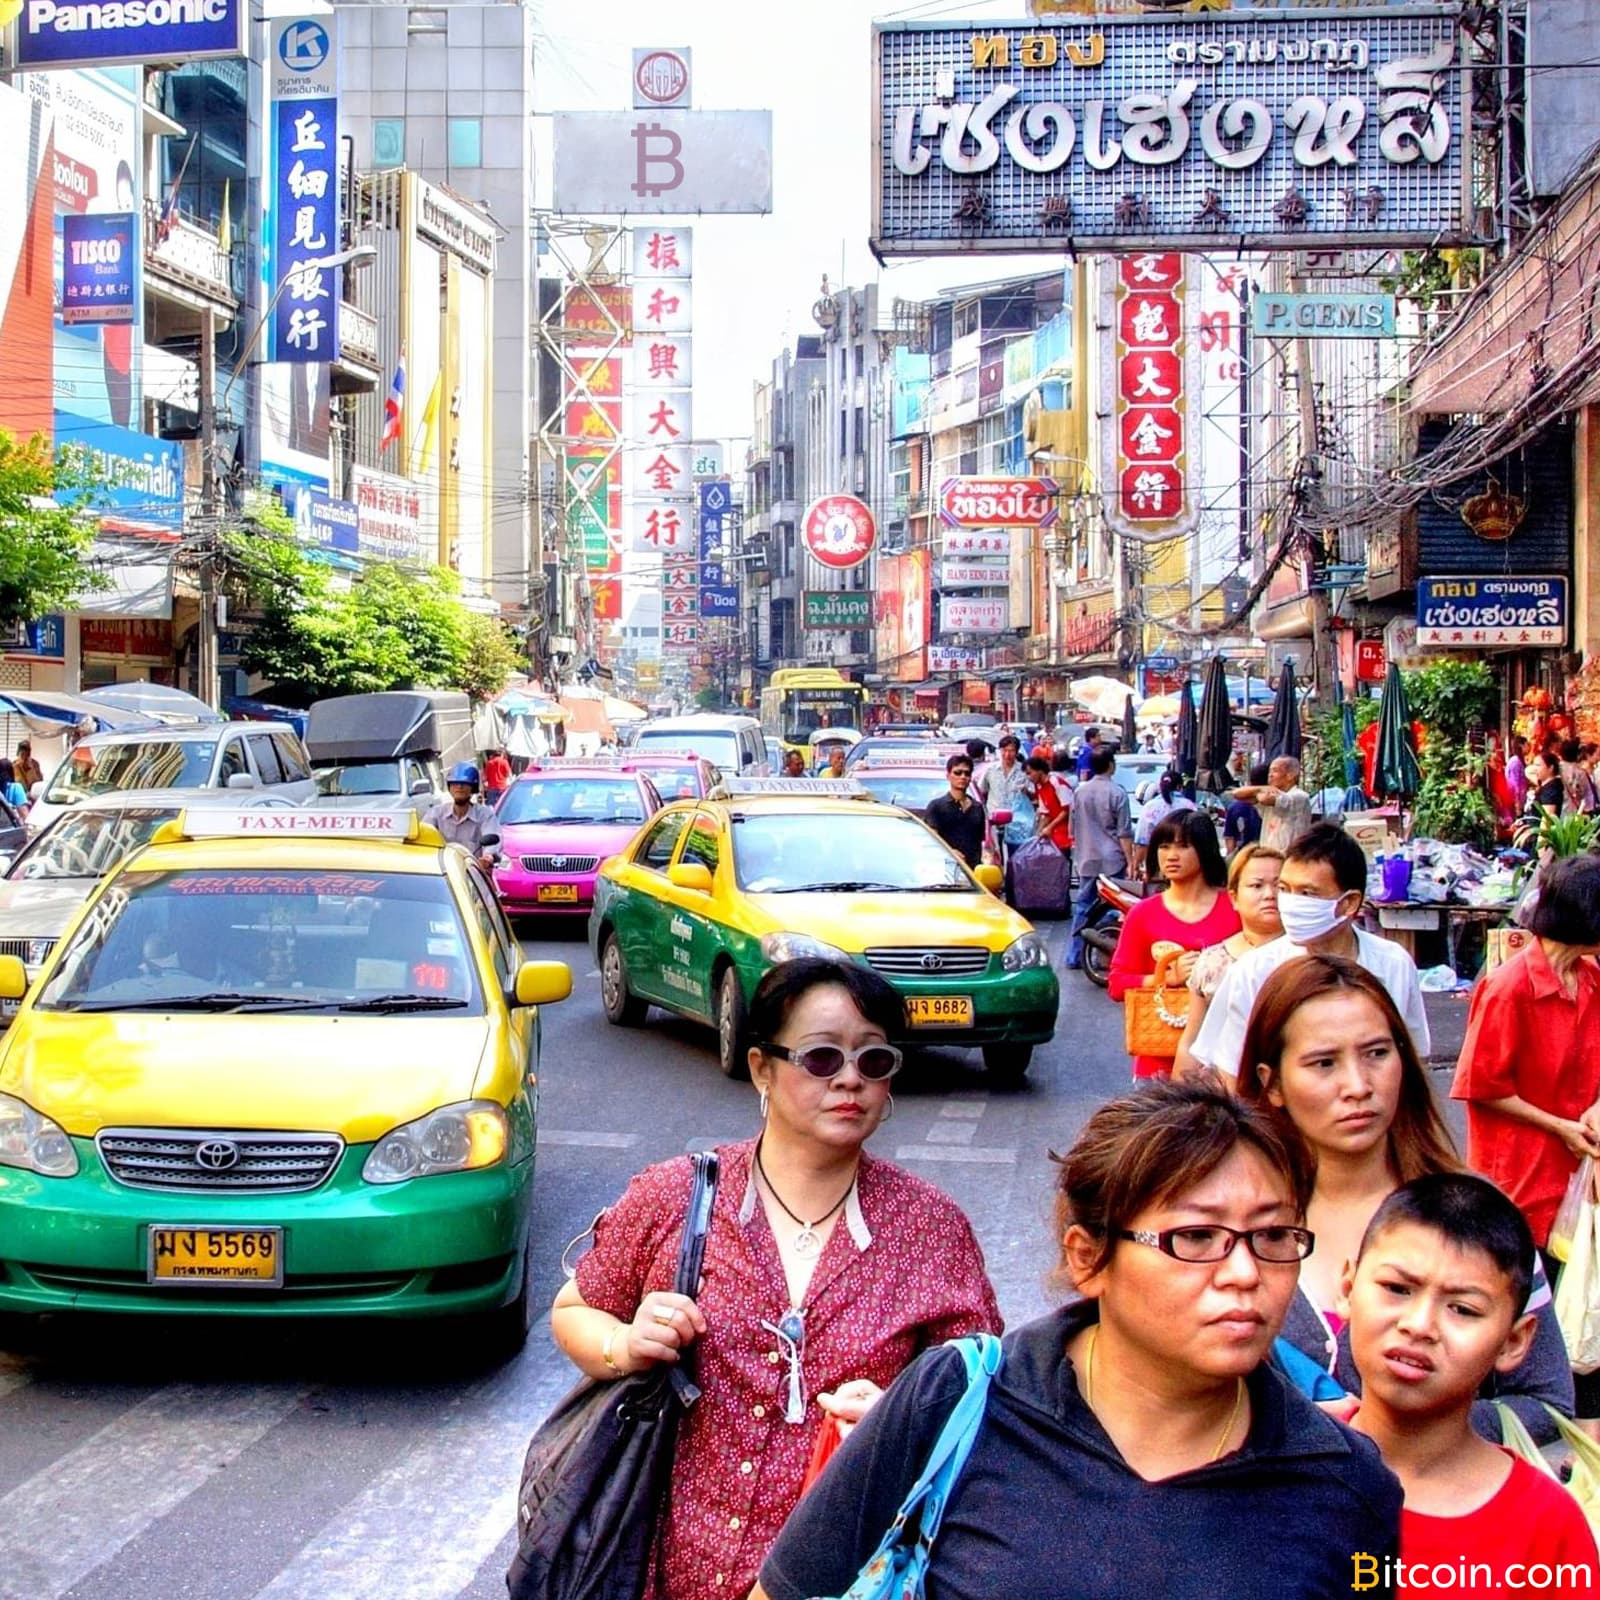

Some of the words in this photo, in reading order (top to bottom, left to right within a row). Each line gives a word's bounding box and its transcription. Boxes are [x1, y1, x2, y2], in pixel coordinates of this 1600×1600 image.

[28, 0, 228, 34] Panasonic
[969, 34, 1106, 69] ทอง
[286, 108, 330, 351] 丘細見銀行
[71, 239, 120, 264] TISCO
[95, 264, 120, 274] Bank
[643, 231, 682, 546] 振和興大金行
[1432, 583, 1476, 597] ทอง
[714, 595, 736, 606] UOB
[759, 779, 852, 793] TAXI-METER
[237, 815, 394, 830] TAXI-METER
[182, 887, 227, 895] LONG
[234, 887, 268, 895] LIVE
[275, 886, 307, 895] THE
[314, 886, 356, 895] KING
[934, 1001, 967, 1014] 9682
[158, 1231, 196, 1257] มง
[207, 1232, 273, 1258] 5569
